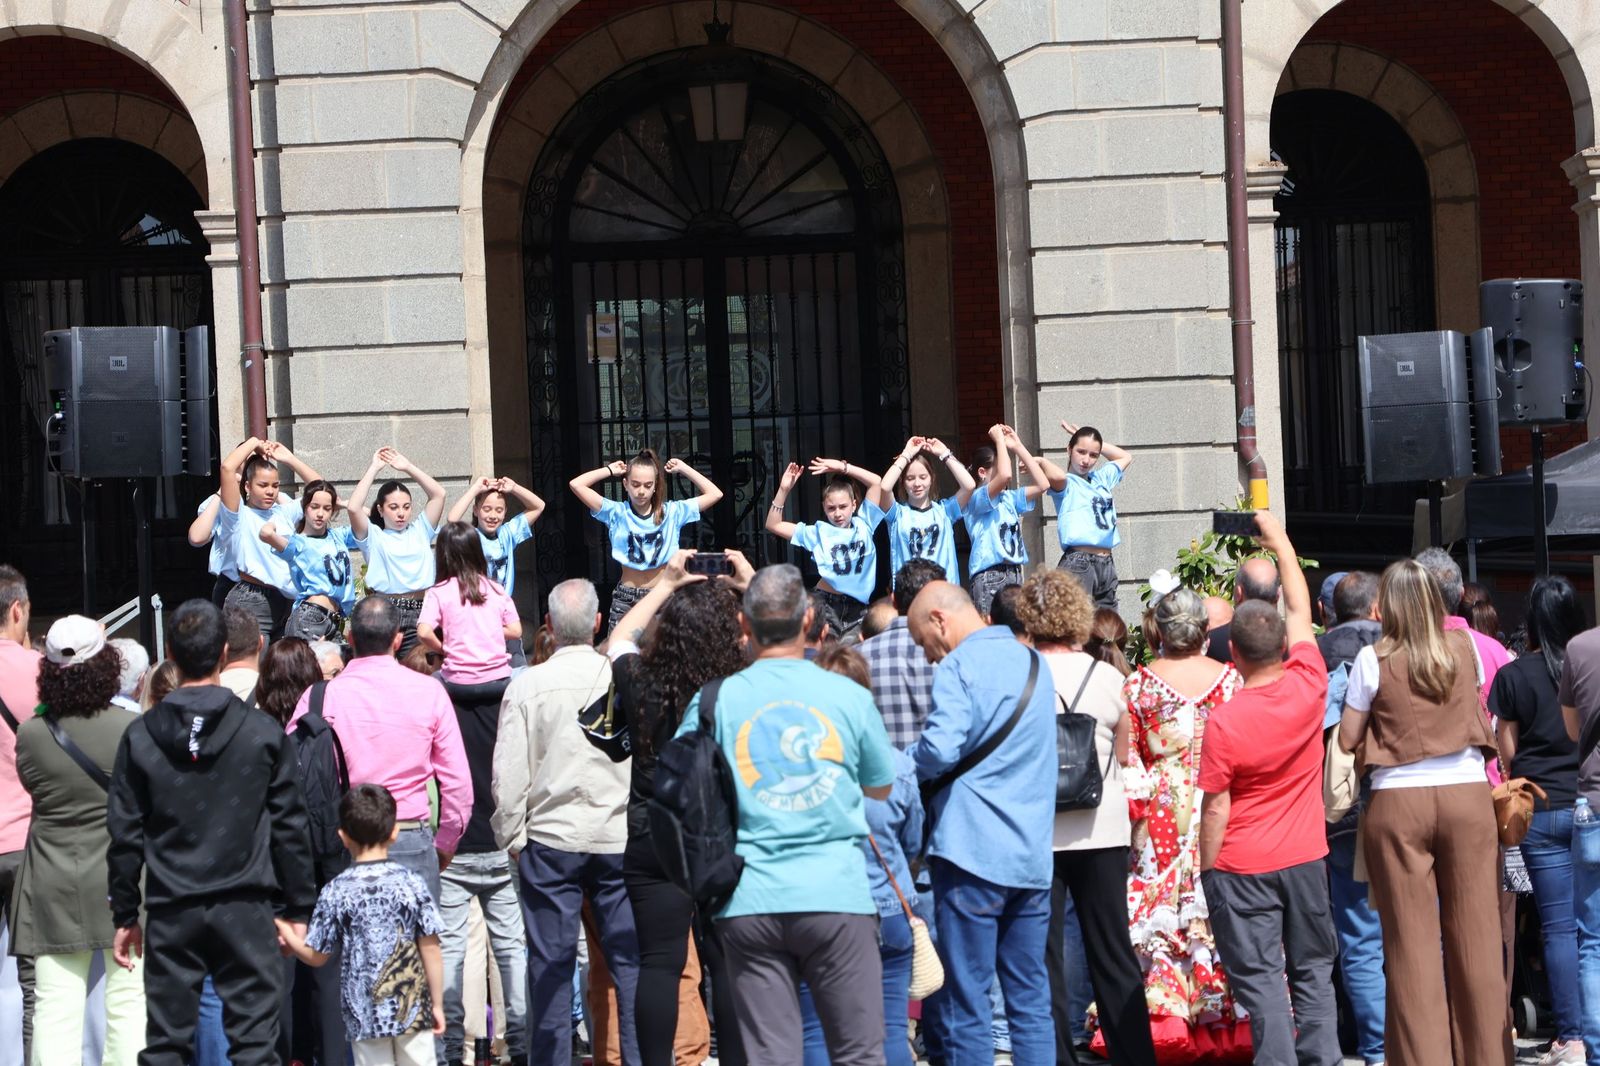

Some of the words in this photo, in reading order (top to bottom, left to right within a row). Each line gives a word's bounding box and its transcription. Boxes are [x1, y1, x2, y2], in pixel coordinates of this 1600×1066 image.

[628, 531, 664, 567] 07
[831, 540, 866, 576] 07
[910, 524, 939, 558] 07
